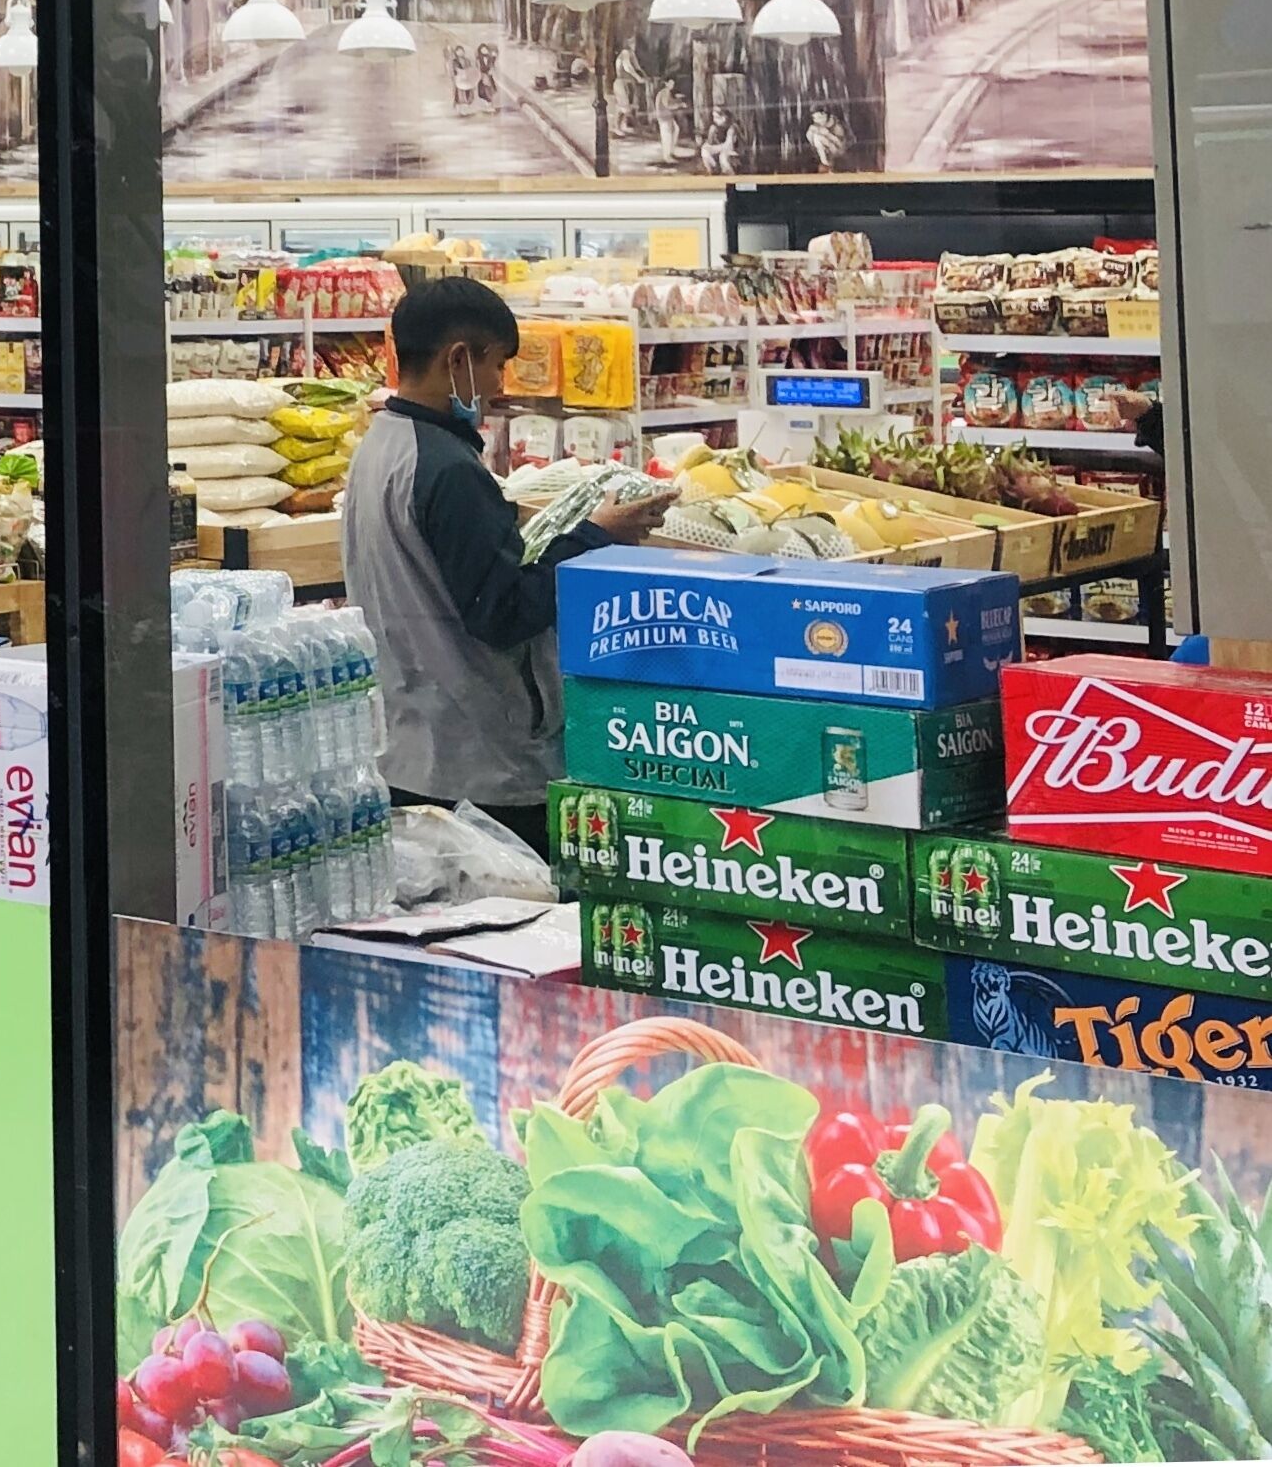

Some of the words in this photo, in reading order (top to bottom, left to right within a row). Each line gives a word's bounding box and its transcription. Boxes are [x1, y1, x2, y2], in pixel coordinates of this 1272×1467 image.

[592, 588, 733, 635] BLUECAP
[804, 599, 862, 616] SAPPORO
[887, 617, 913, 634] 24
[887, 634, 914, 644] CANS
[589, 626, 687, 659] PREMIUM
[698, 627, 739, 653] BEER
[655, 701, 699, 726] BIA
[955, 713, 974, 729] BIA
[607, 717, 751, 769] SAIGON
[937, 728, 994, 760] SAIGON
[624, 757, 736, 794] SPECIAL
[627, 796, 645, 809] 24
[6, 764, 42, 890] evian
[623, 835, 885, 915] Heineken
[1011, 851, 1030, 867] 24
[663, 906, 679, 921] 24
[1008, 892, 1272, 977] Heineke
[660, 944, 925, 1033] Heineken
[1054, 993, 1272, 1084] Tiger
[1215, 1074, 1259, 1087] 1932
